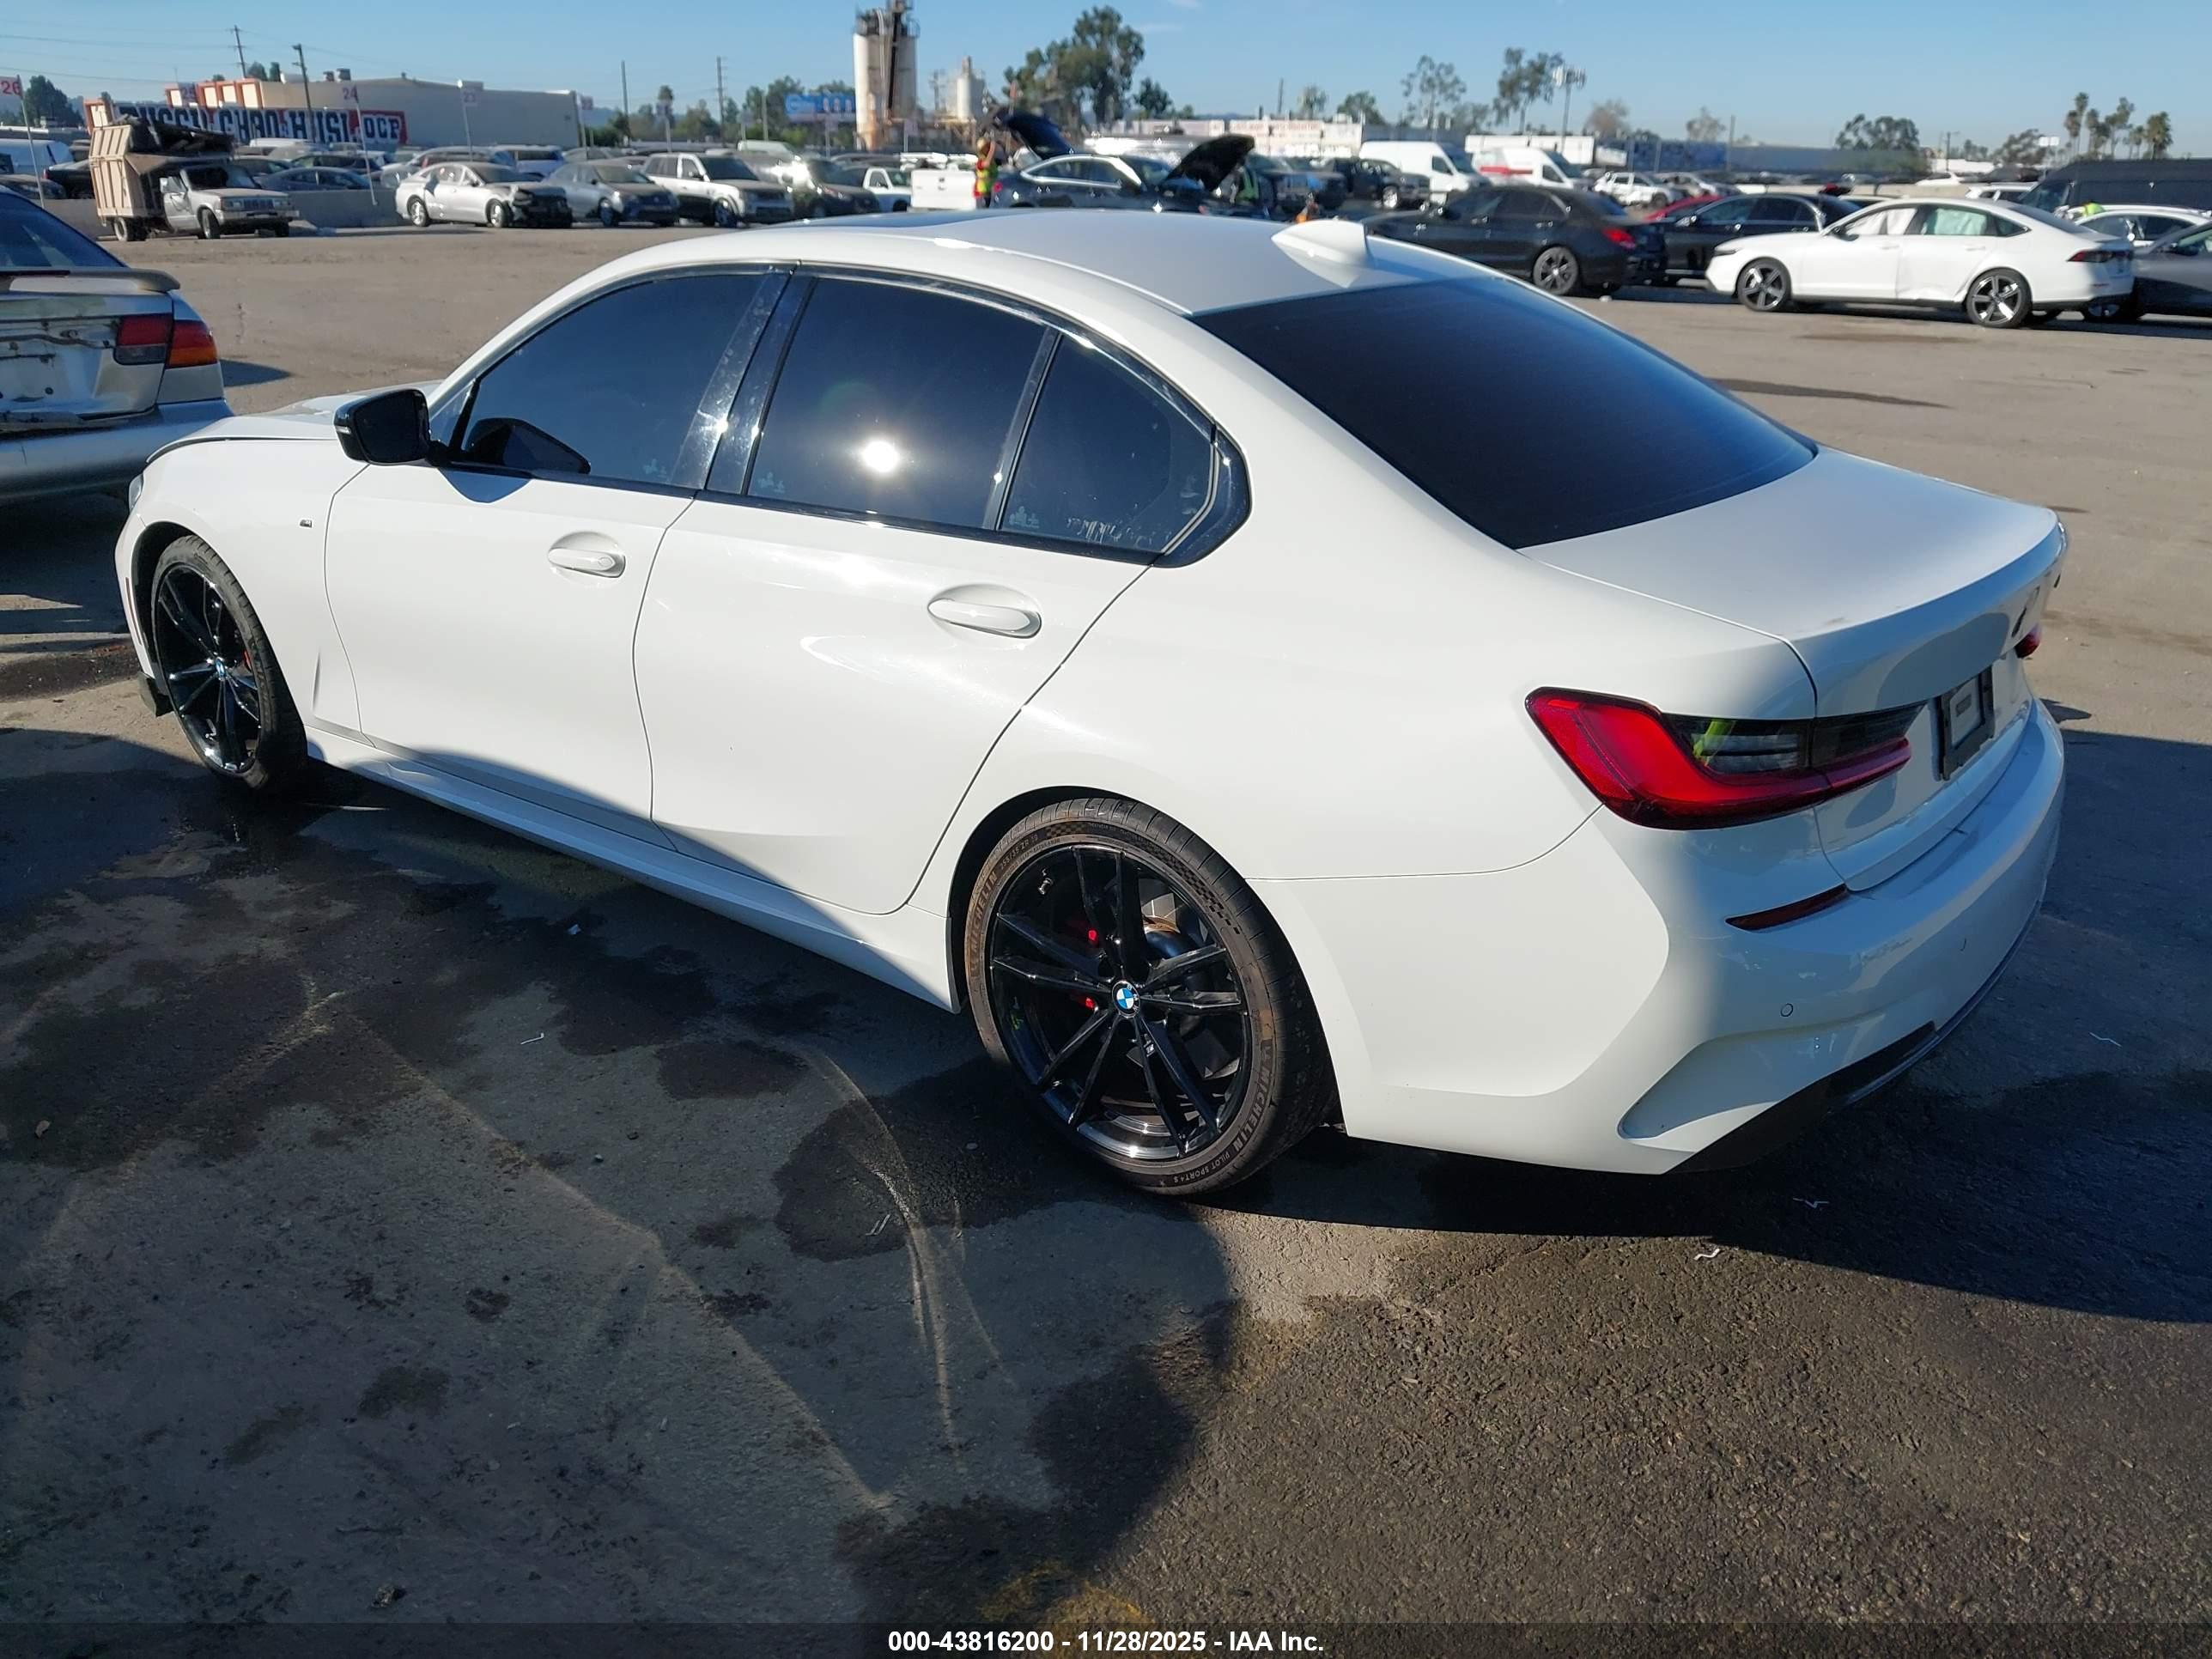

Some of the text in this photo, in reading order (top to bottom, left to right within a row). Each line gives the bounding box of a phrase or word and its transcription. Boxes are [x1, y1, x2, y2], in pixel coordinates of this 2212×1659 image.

[1, 80, 21, 95] 26
[343, 87, 358, 100] 24
[1232, 1066, 1270, 1151] MICHELIN
